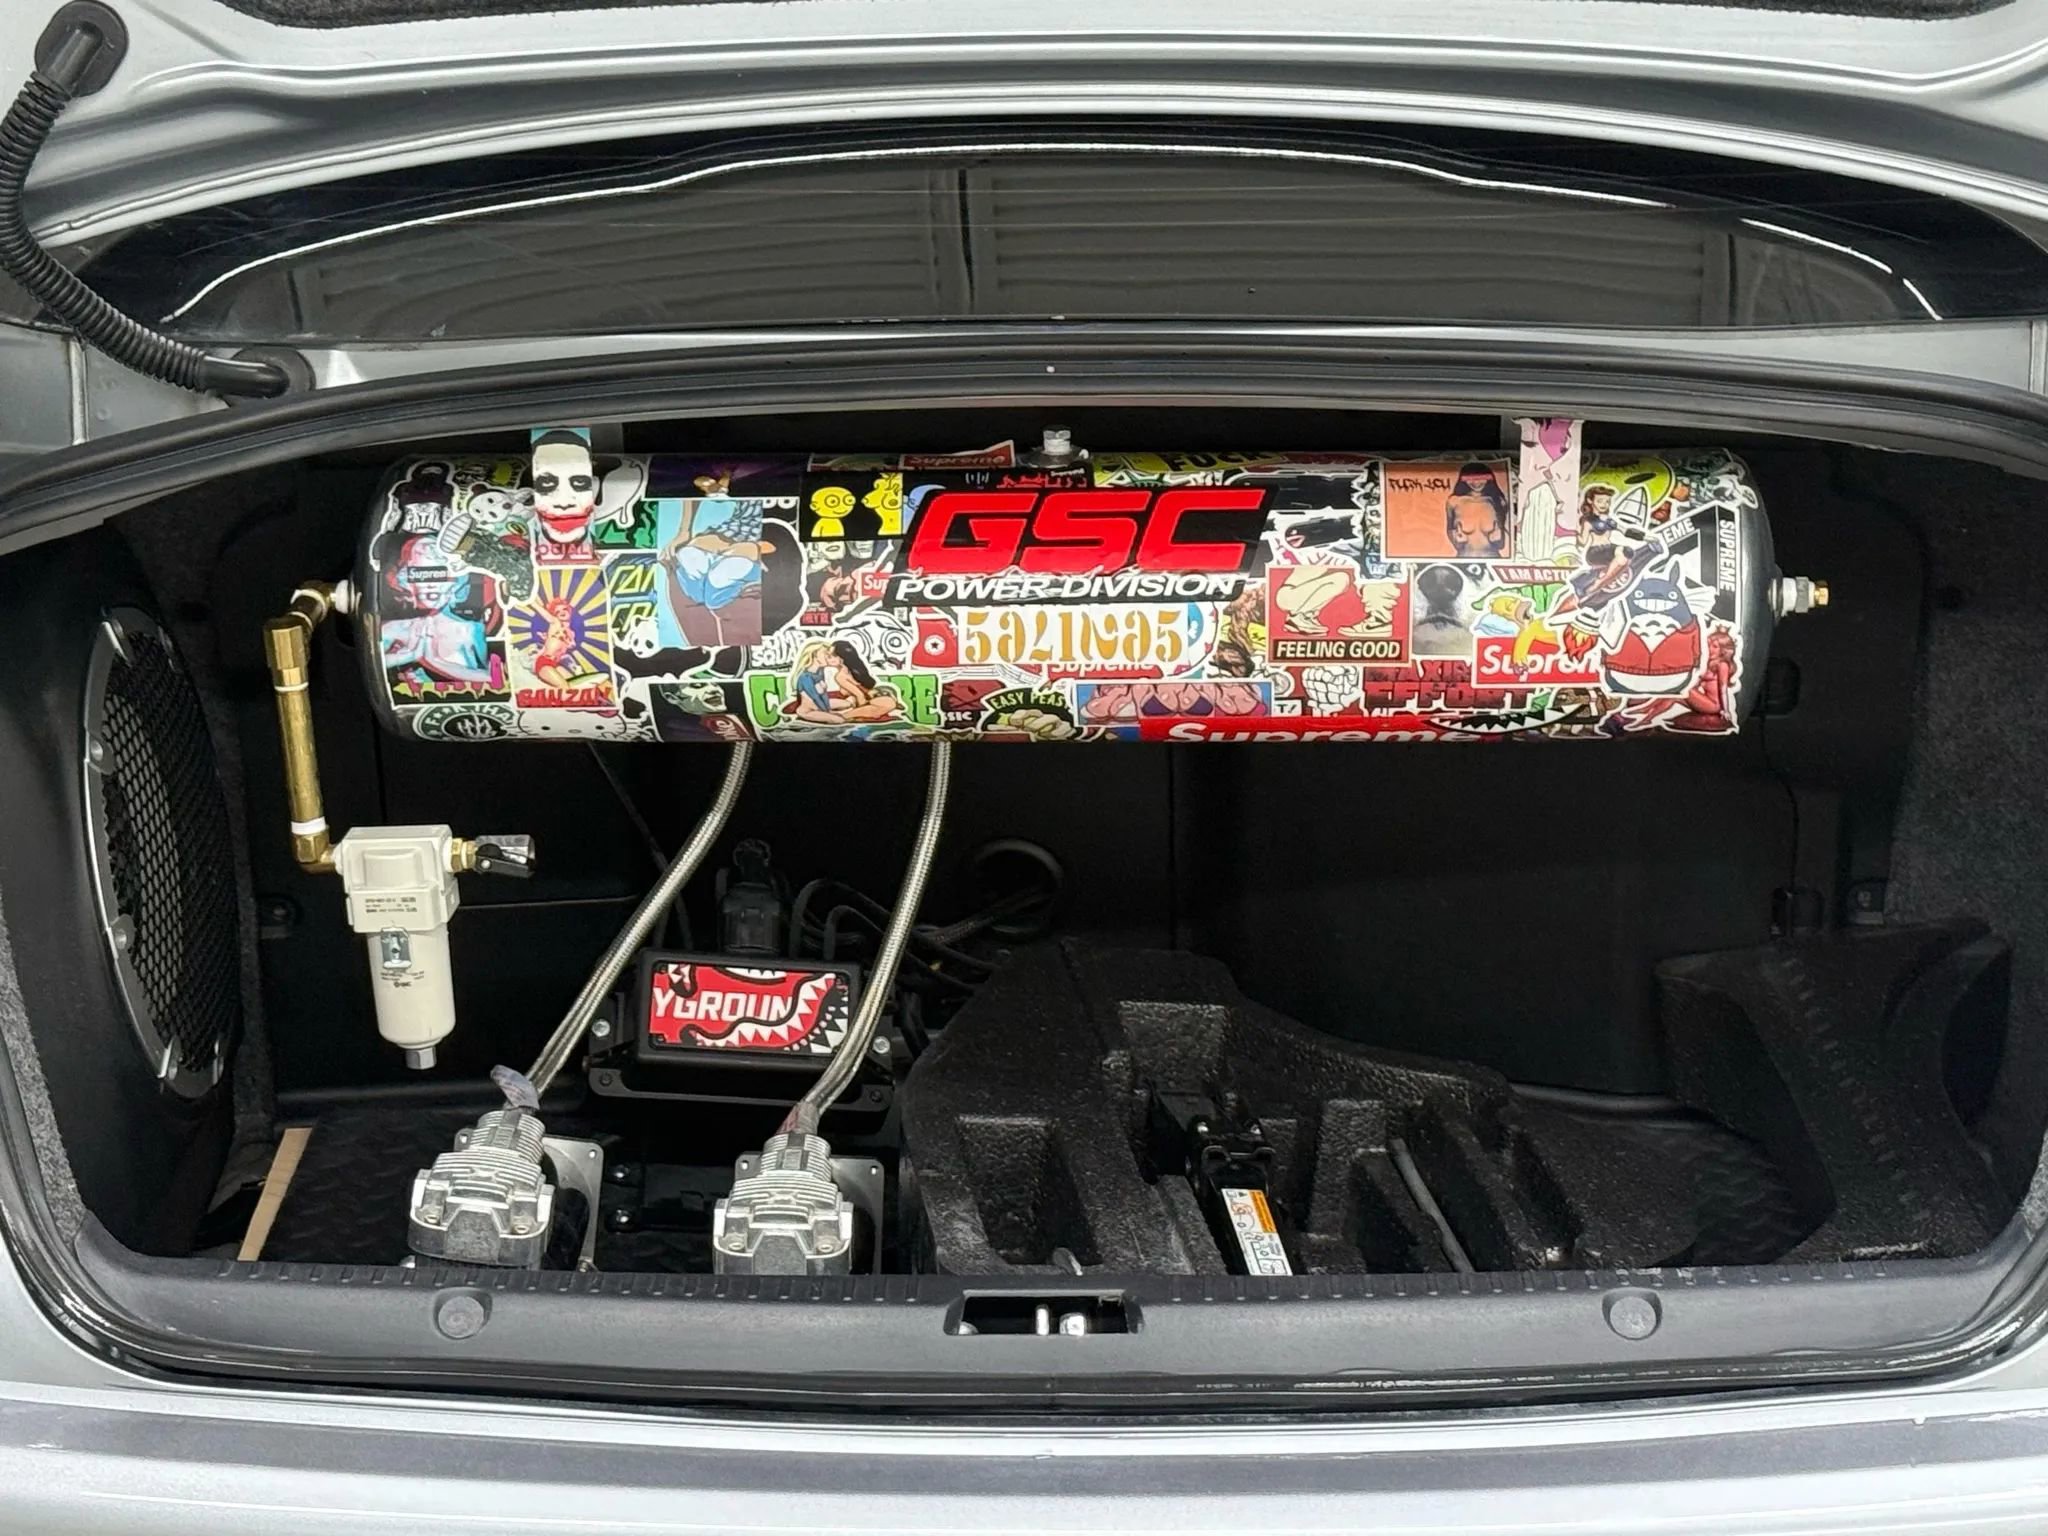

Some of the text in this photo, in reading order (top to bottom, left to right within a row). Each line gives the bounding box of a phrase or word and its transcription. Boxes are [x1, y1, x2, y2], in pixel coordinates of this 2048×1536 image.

[907, 489, 1266, 574] GSC
[1719, 519, 1736, 592] SUPREME
[1277, 641, 1401, 659] FEELING GOOD
[990, 691, 1024, 710] EASY
